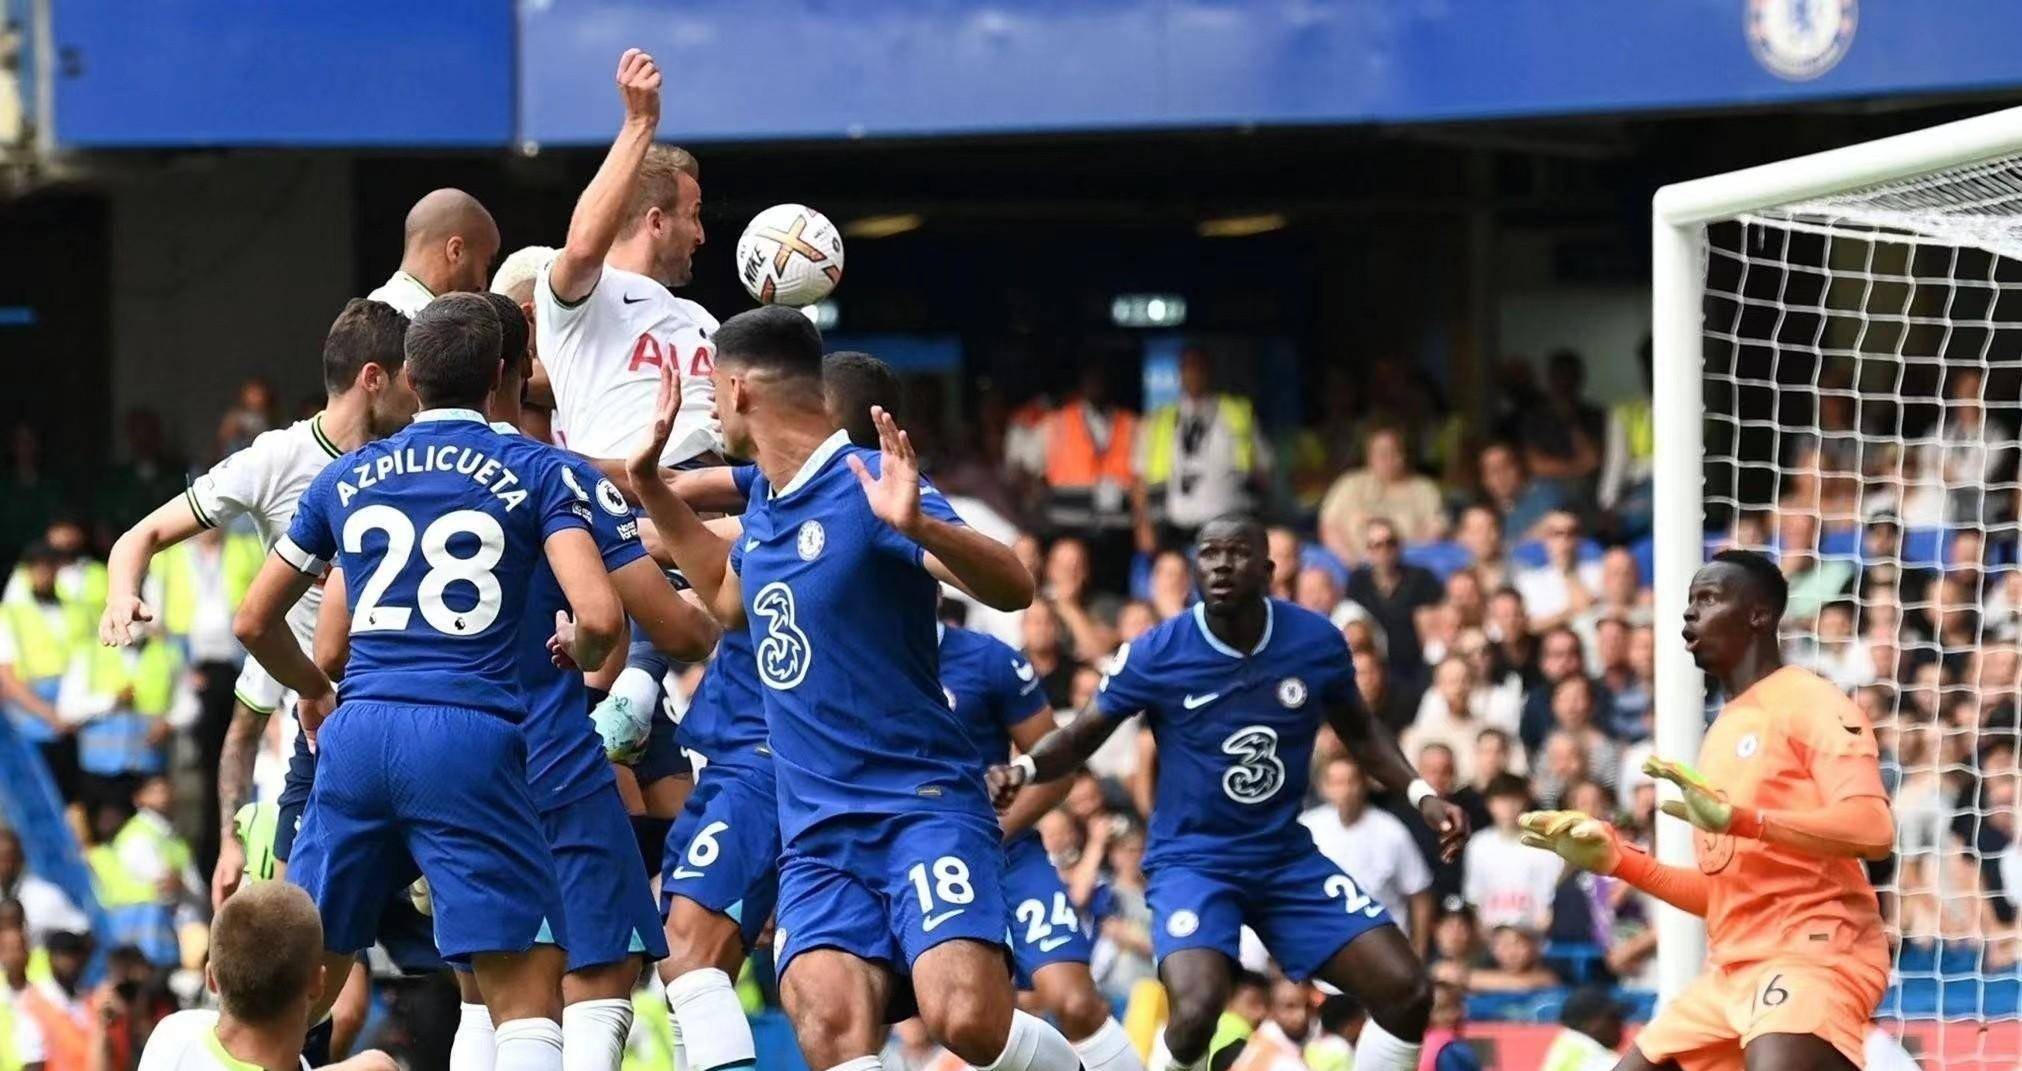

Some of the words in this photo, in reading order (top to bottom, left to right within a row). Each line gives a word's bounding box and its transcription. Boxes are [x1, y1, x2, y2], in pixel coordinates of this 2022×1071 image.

[336, 445, 528, 512] AZPILICUETA
[342, 504, 505, 636] 28
[687, 820, 729, 867] 6
[908, 855, 975, 914] 18
[1015, 891, 1078, 944] 24
